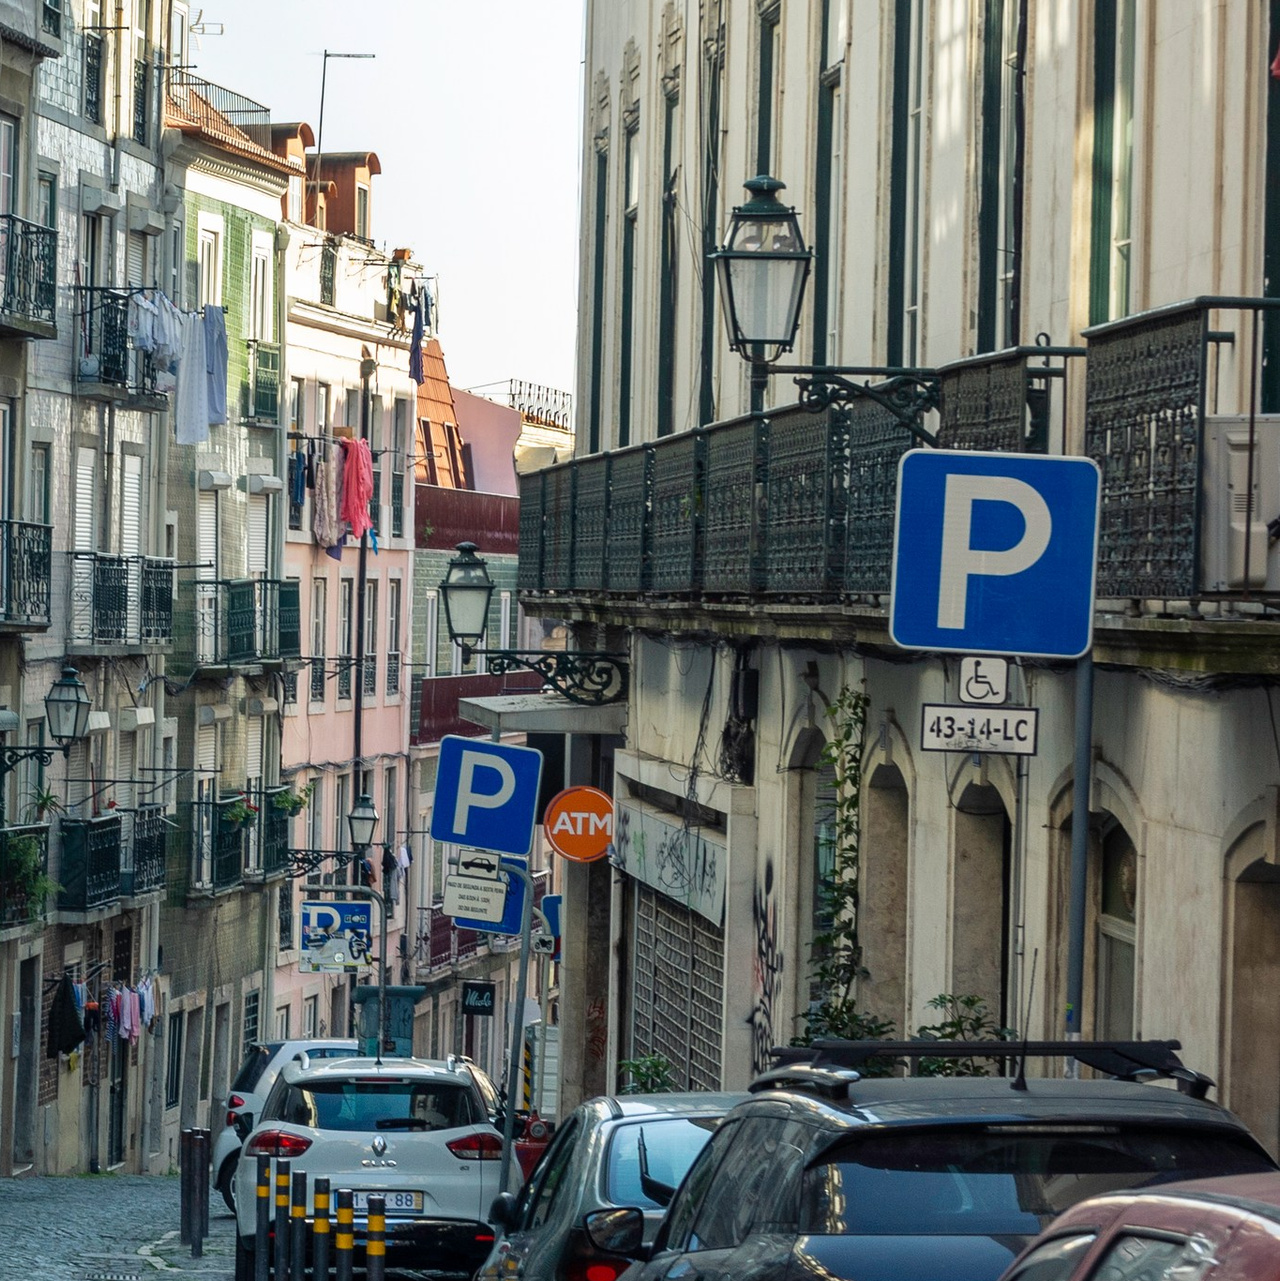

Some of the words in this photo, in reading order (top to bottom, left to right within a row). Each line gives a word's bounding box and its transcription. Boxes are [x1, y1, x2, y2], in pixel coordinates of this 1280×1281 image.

[937, 473, 1053, 630] P
[929, 716, 1028, 742] 43-14-LC
[453, 750, 516, 836] P
[552, 811, 613, 836] ATM
[310, 905, 341, 938] P
